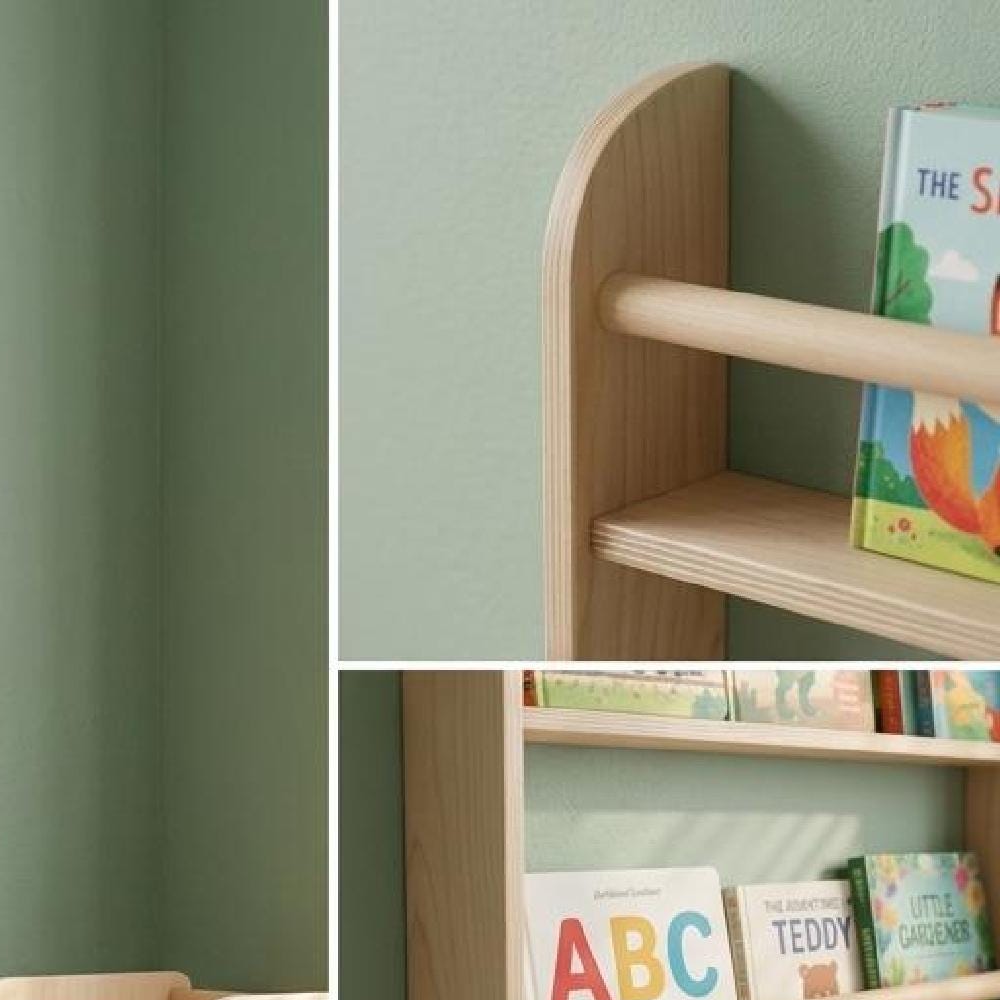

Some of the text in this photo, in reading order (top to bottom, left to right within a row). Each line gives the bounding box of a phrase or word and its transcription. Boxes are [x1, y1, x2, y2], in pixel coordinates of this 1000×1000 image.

[917, 166, 1000, 216] THE S
[771, 916, 850, 955] TEDDY
